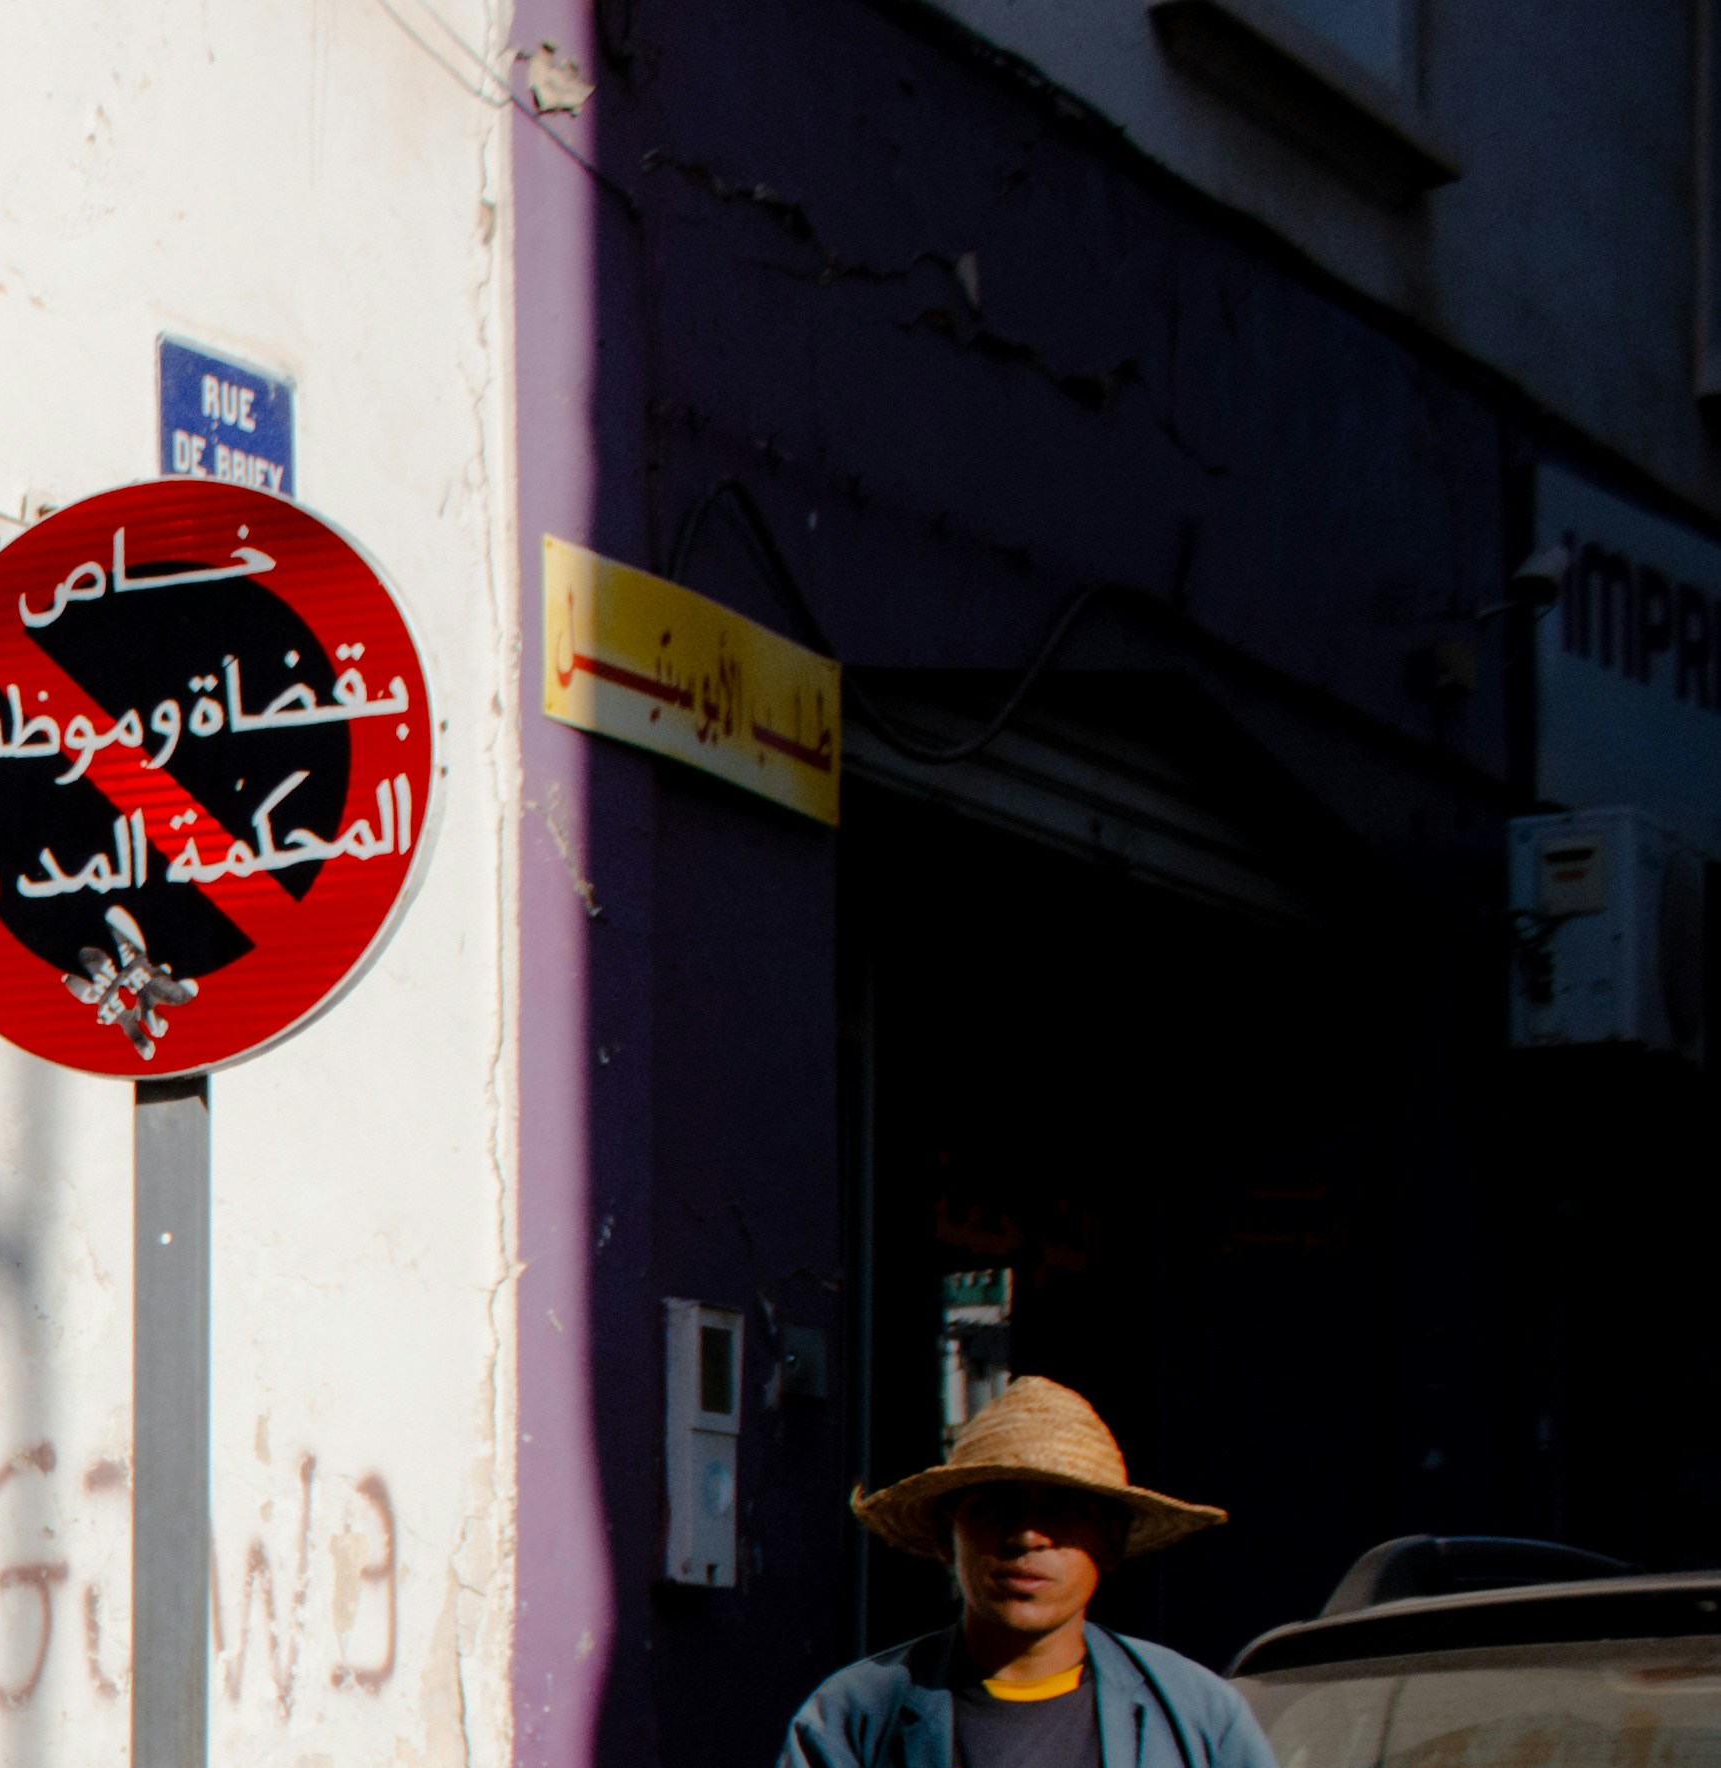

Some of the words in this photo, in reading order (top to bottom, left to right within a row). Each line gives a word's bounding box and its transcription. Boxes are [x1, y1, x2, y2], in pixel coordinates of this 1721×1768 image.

[201, 372, 257, 434] RUE
[172, 428, 207, 477] DE
[18, 523, 277, 629] خاص
[166, 770, 411, 883] المحكمة
